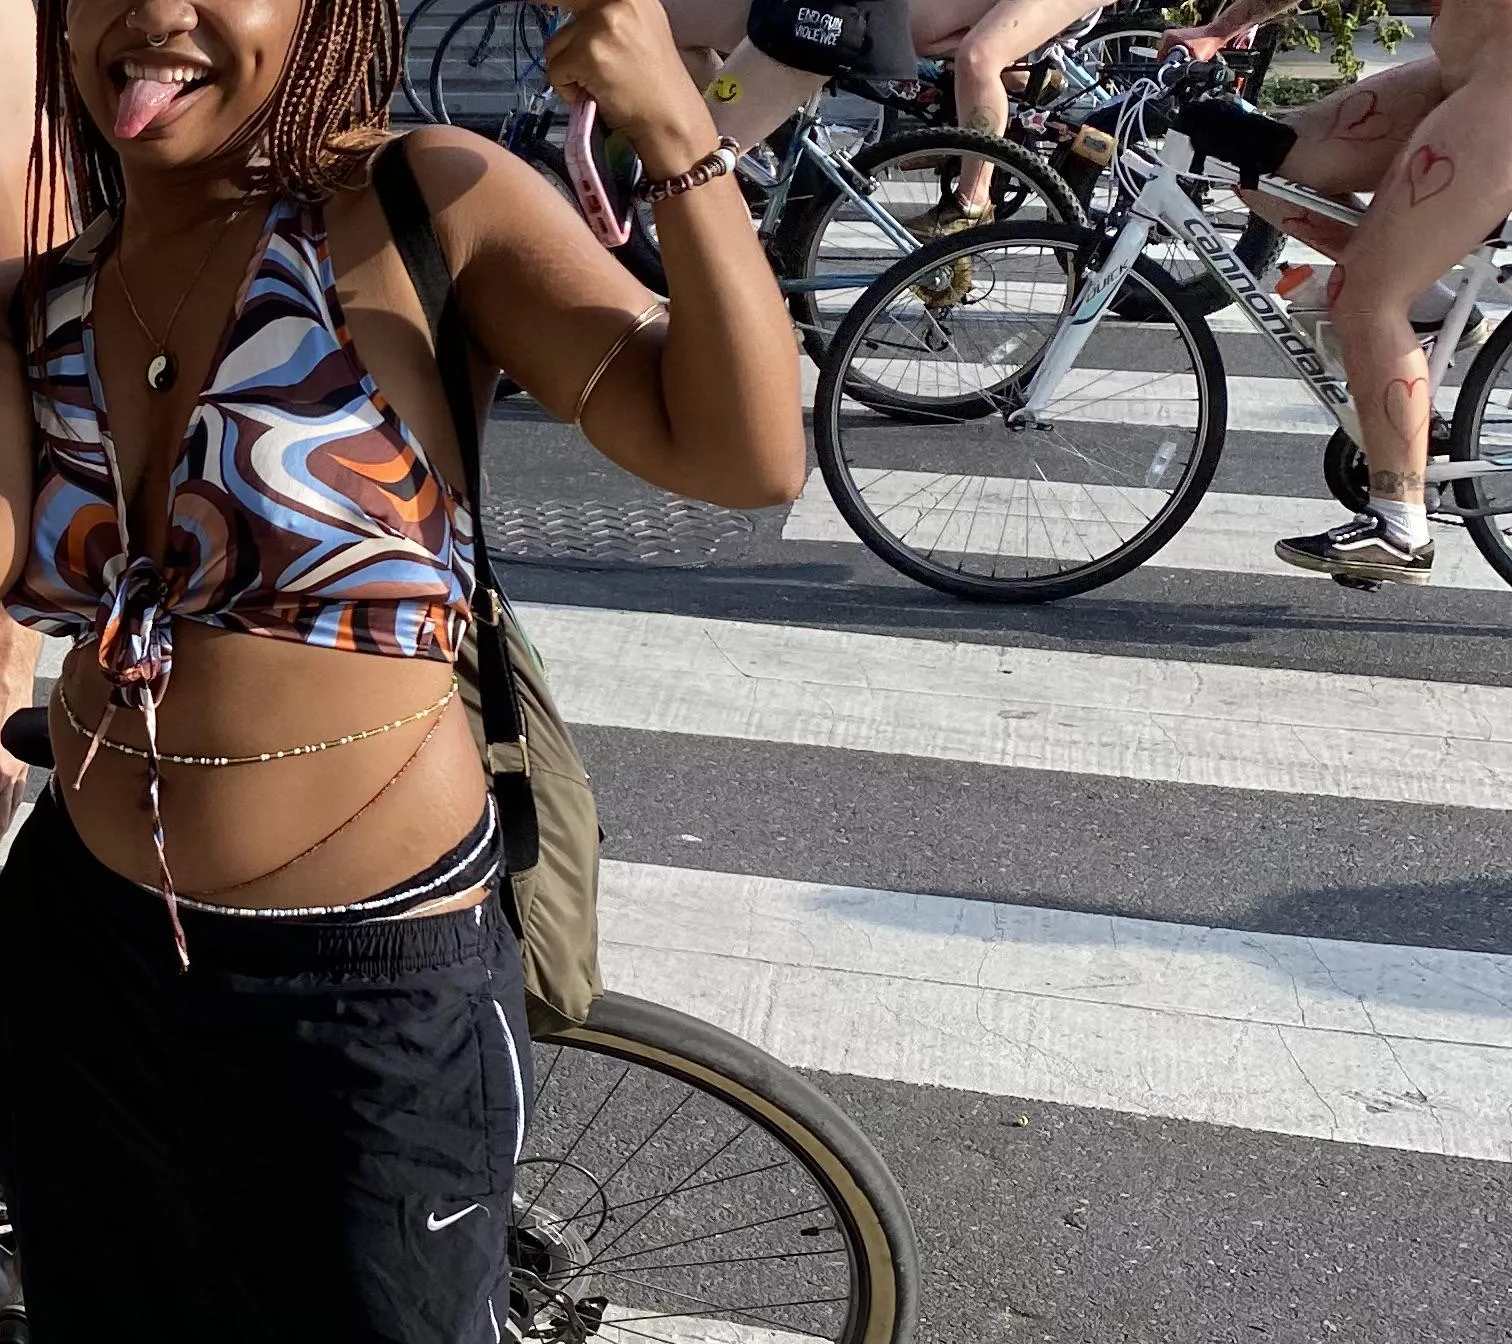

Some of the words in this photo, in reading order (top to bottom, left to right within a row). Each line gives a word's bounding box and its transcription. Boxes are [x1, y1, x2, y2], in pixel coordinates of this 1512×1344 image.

[794, 24, 841, 46] VIOLENCE
[797, 7, 821, 23] END
[820, 13, 844, 30] GUN
[1085, 259, 1132, 304] QUICK
[1183, 218, 1349, 405] cannondale
